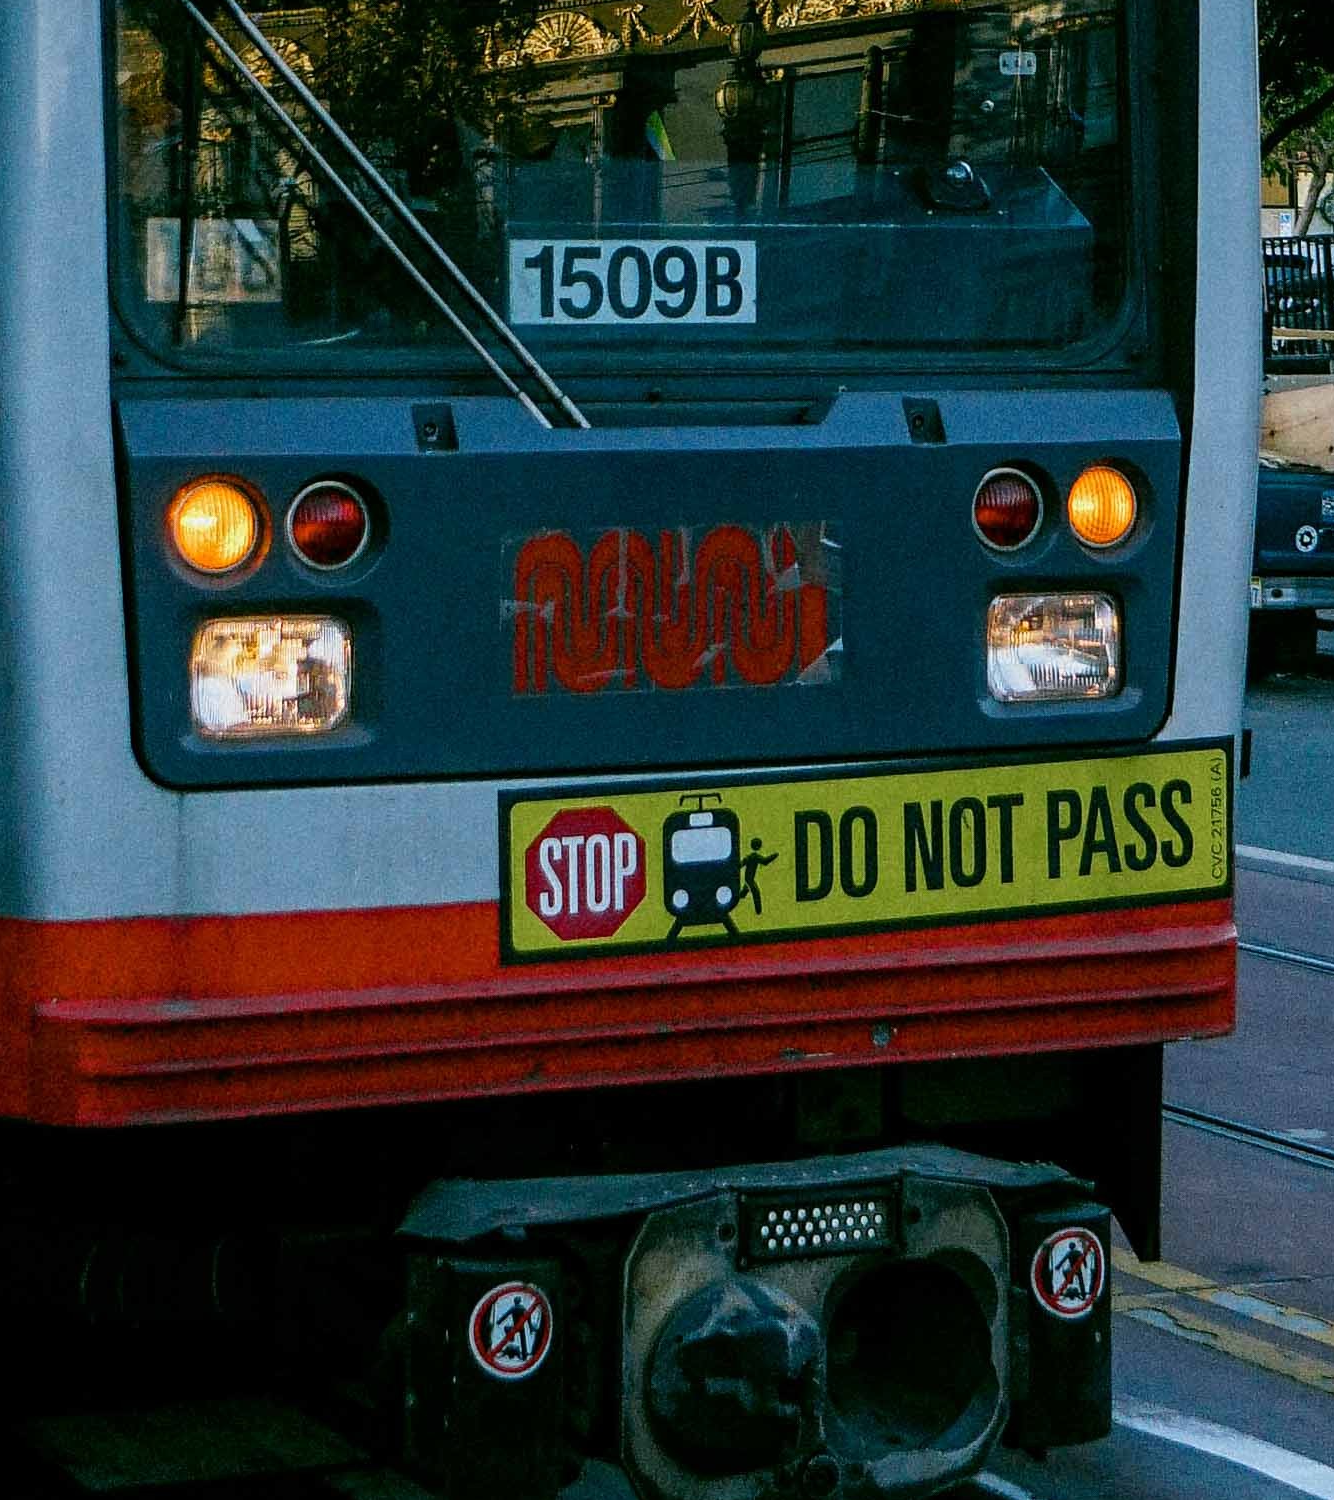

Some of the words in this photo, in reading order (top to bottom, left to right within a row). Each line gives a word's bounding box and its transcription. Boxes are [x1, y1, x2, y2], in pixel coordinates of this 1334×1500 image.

[522, 244, 743, 320] 1509B
[793, 804, 880, 902] DO
[903, 792, 1024, 893] NOT
[1044, 778, 1195, 875] PASS
[1211, 786, 1222, 840] 21756
[538, 830, 639, 917] STOP
[1211, 844, 1223, 880] CVC
